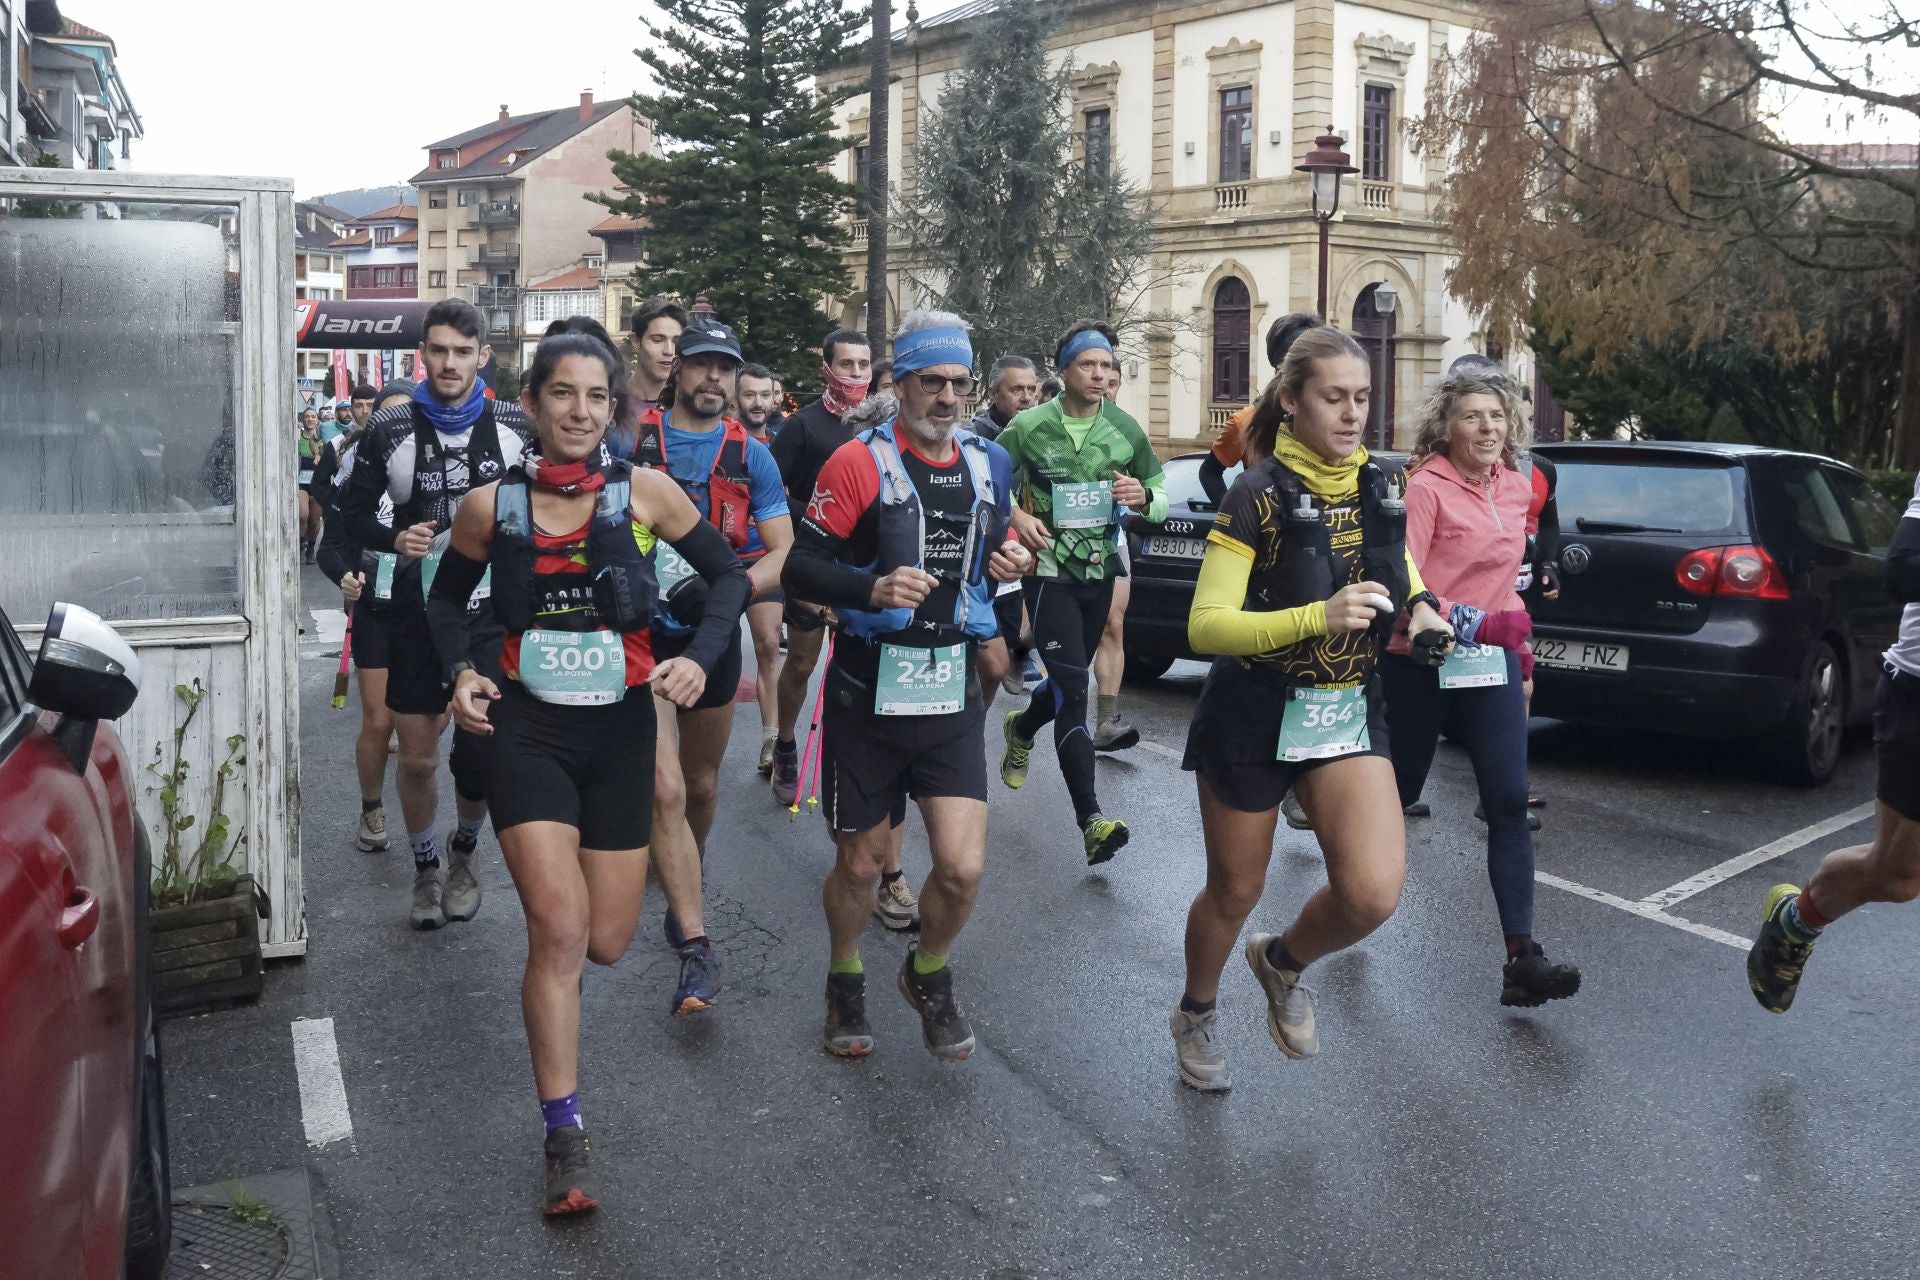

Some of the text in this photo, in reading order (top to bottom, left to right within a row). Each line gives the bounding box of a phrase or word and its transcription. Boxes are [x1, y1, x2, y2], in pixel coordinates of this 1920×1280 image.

[421, 480, 444, 491] MAX
[930, 473, 962, 484] land
[1065, 491, 1101, 508] 365
[1153, 538, 1187, 555] 9830
[662, 553, 699, 577] 26
[540, 646, 605, 671] 300
[1534, 640, 1620, 667] 422 FNZ
[896, 661, 952, 683] 248
[926, 682, 945, 690] PEÑA
[1302, 702, 1353, 728] 364
